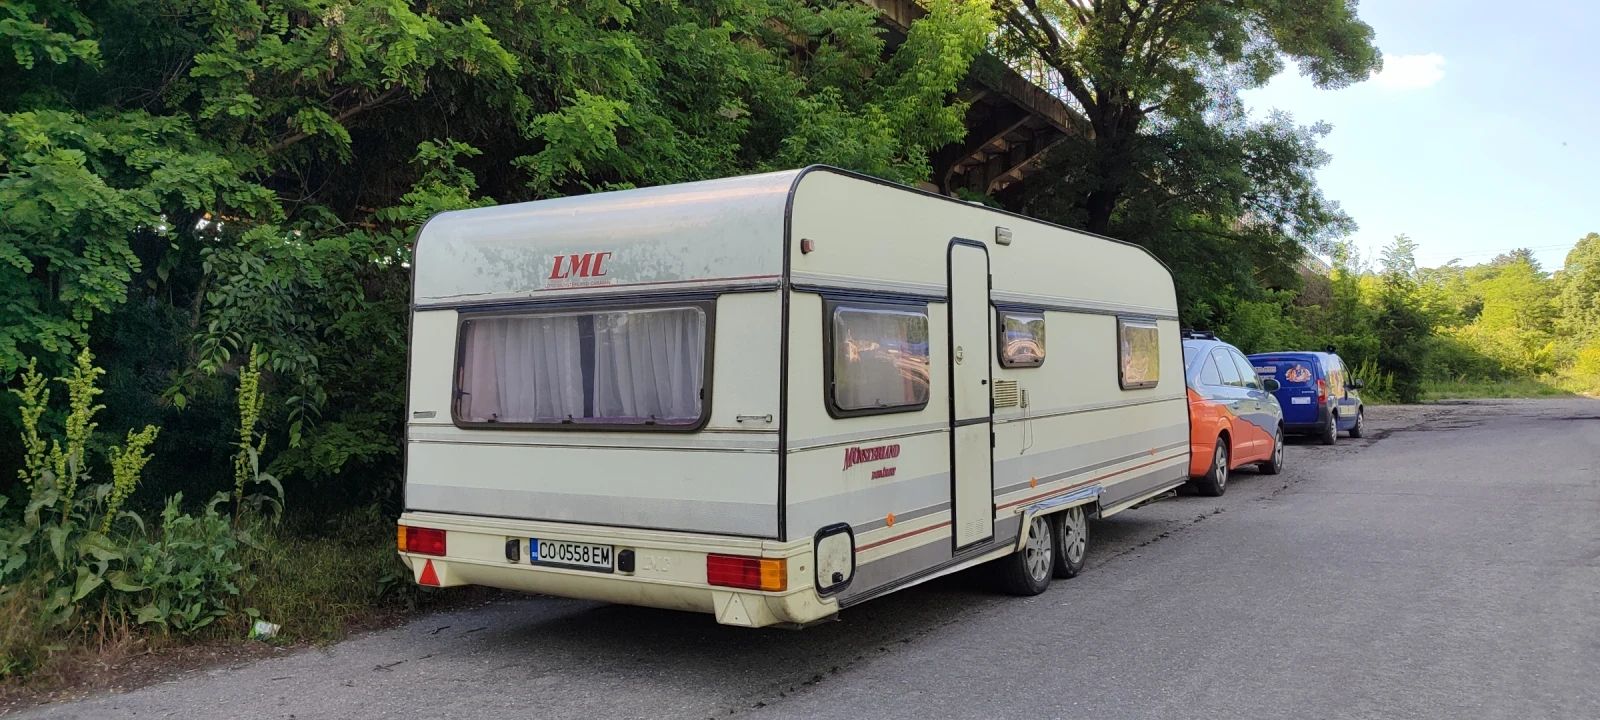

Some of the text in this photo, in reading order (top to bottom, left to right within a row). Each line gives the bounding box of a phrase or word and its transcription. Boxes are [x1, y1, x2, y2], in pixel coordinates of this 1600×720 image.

[548, 252, 611, 279] LMC
[540, 542, 610, 565] CO 0558 EM
